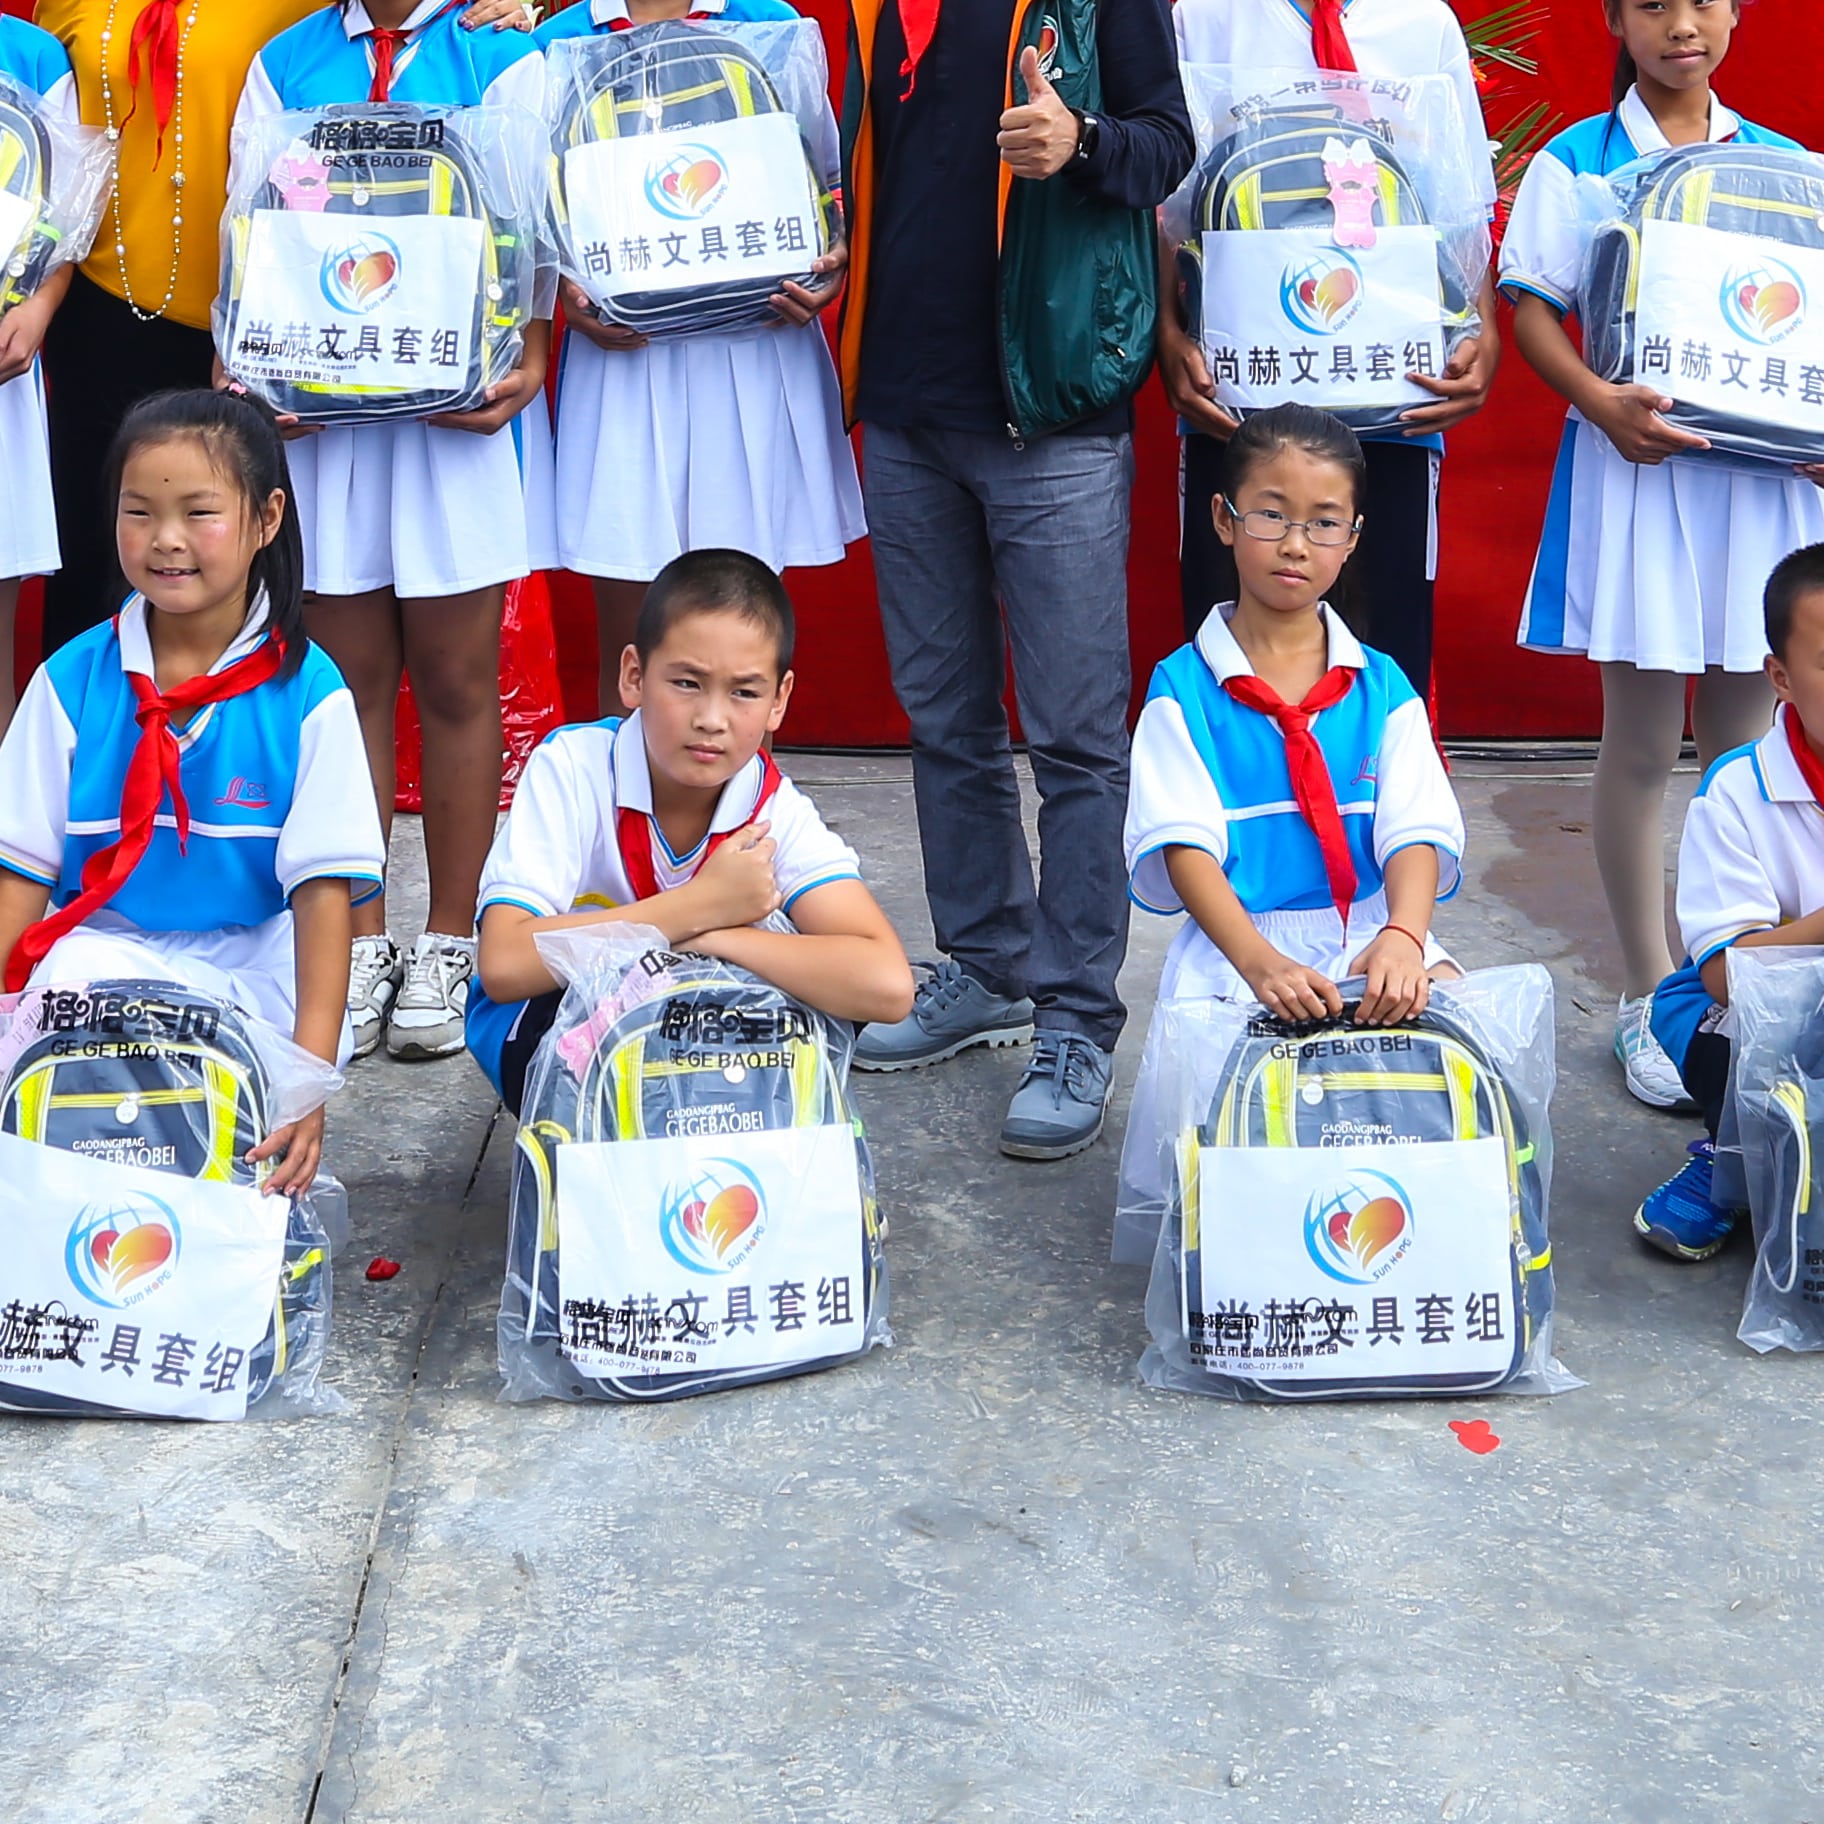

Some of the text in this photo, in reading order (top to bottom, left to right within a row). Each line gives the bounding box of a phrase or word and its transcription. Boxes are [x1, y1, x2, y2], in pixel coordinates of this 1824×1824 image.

[310, 119, 446, 152] 格格宝贝
[322, 156, 433, 168] GE GE BAO BEI
[583, 215, 809, 281] 尚赫文具套组
[244, 319, 460, 367] 尚赫文具套组
[1213, 340, 1436, 387] 尚赫文具套组
[51, 1039, 198, 1070] GE GE BAO BEI
[687, 1050, 714, 1068] GE
[719, 1052, 762, 1070] BAO
[766, 1052, 795, 1070] BEI
[1270, 1034, 1413, 1061] GE GE BAO BEI
[727, 1224, 765, 1270] SUN HOPE
[1372, 1236, 1413, 1280] SUN HOPE
[123, 1269, 172, 1308] SUN HOPE
[1237, 1362, 1305, 1371] 400-077-9878
